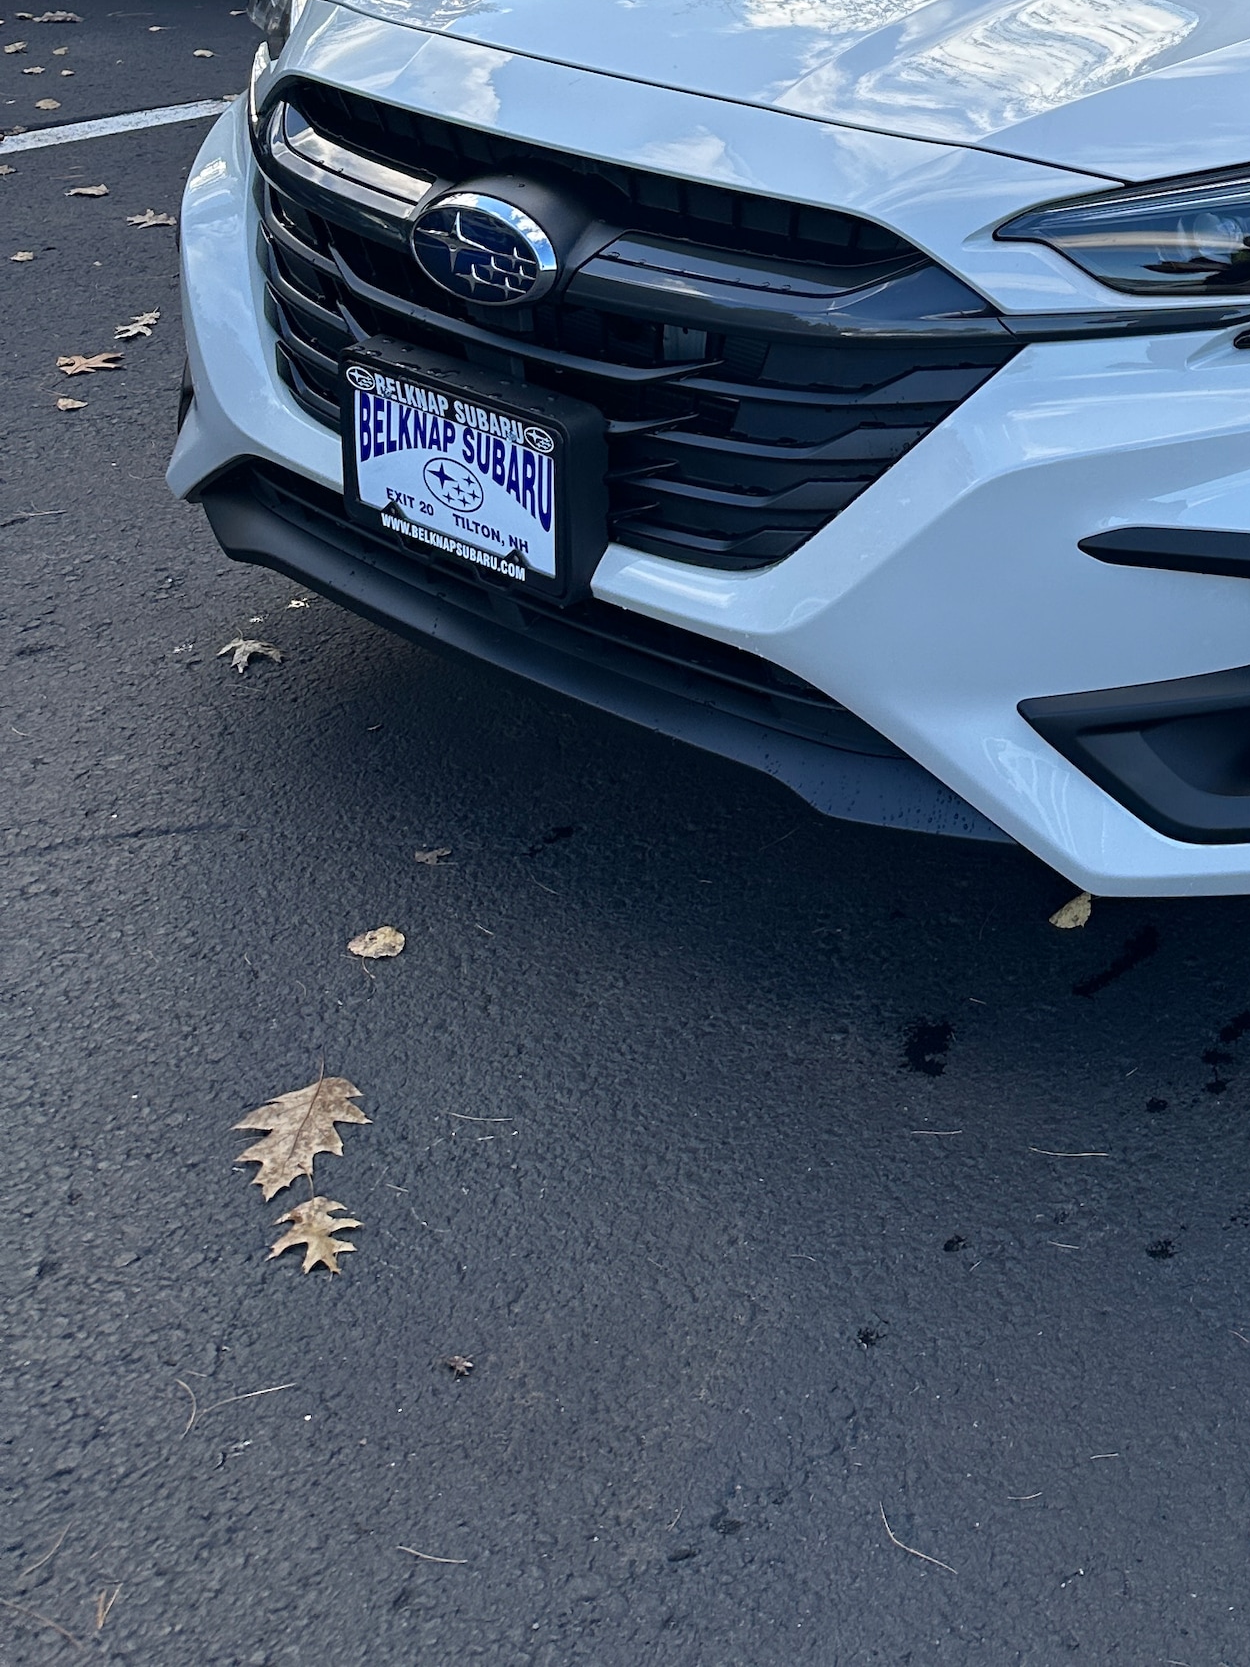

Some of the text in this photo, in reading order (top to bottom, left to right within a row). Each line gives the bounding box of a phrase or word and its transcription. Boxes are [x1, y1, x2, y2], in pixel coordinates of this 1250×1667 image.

[374, 373, 524, 444] BELKNAP SUBARU
[360, 391, 552, 532] BELKNAP SUBARU
[386, 487, 434, 516] EXIT 20
[452, 513, 528, 553] TILTON, NH
[381, 512, 526, 581] WWW.BELKNAPSUBARU.COM
